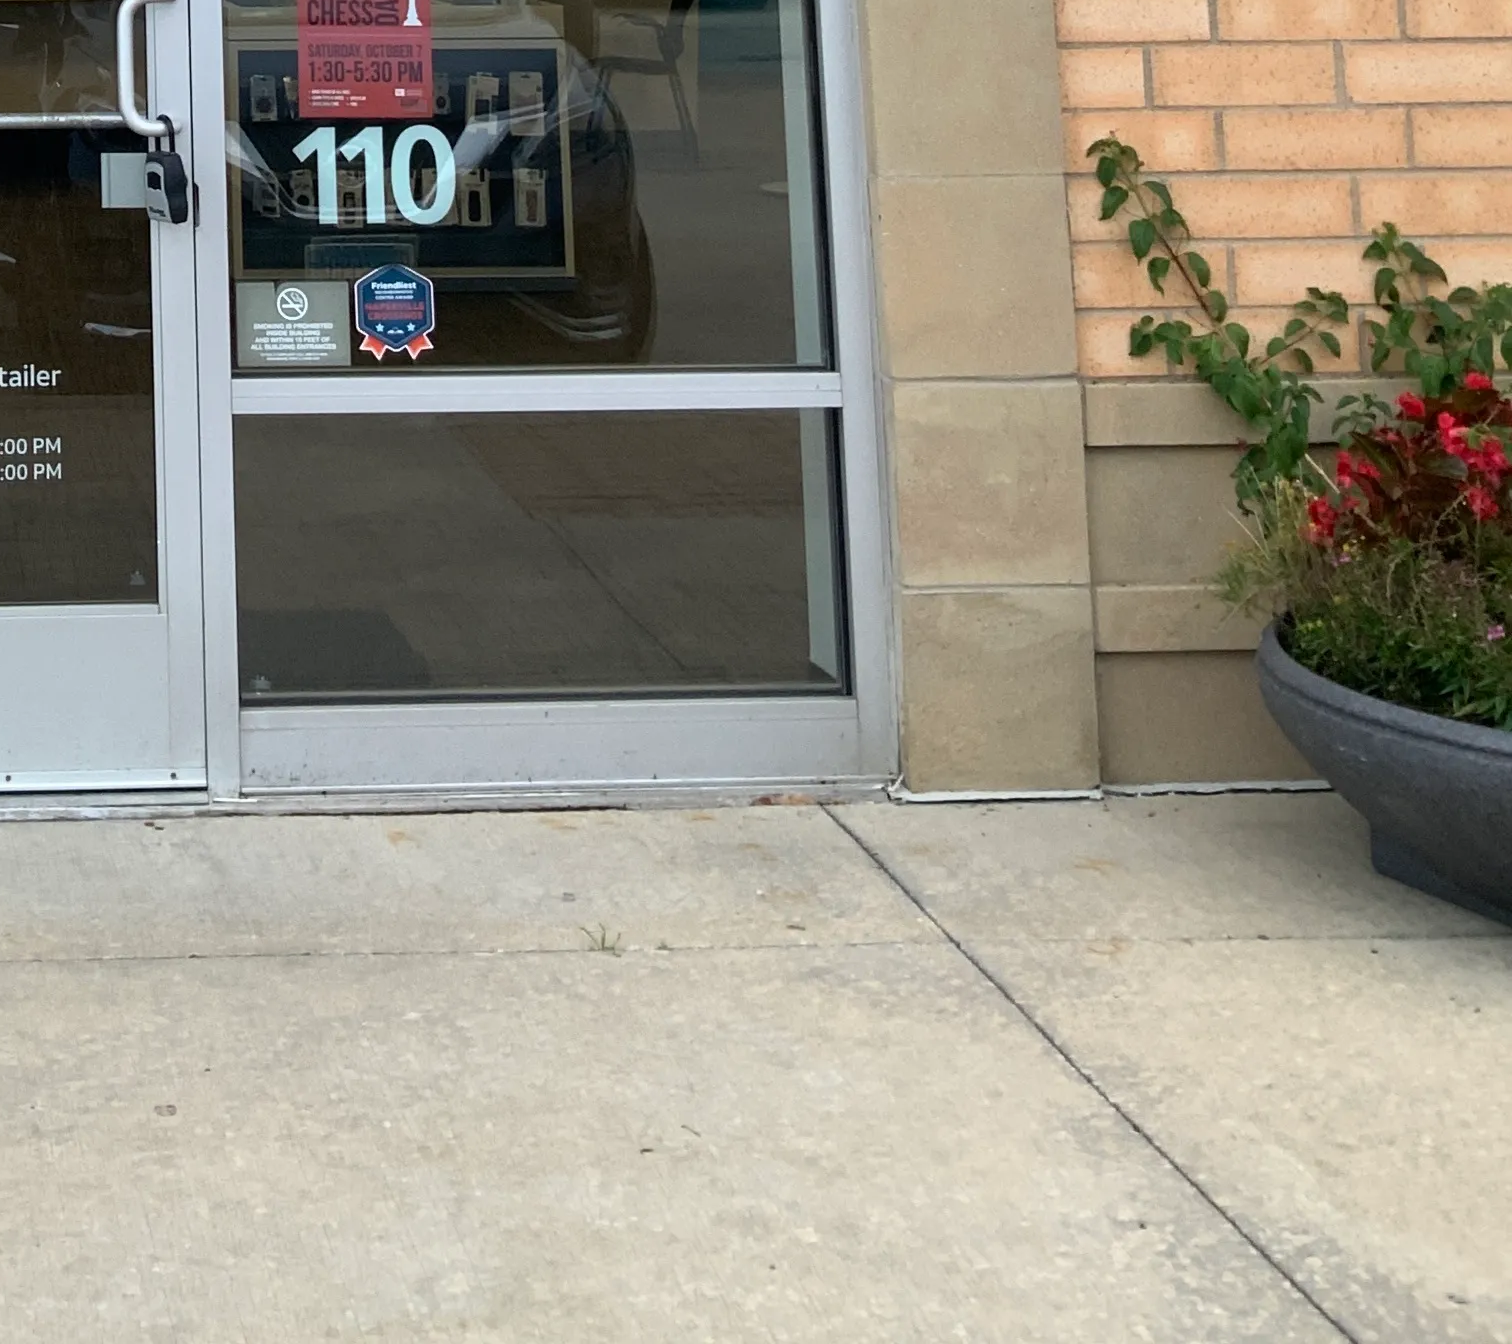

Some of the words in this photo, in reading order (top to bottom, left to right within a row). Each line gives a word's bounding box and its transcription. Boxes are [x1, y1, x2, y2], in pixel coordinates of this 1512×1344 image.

[307, 0, 374, 26] CHESS
[308, 43, 363, 59] SATURDAY,
[365, 44, 413, 58] OCTOBER
[415, 44, 422, 58] 7
[308, 61, 392, 83] 1:30-5:30
[397, 61, 423, 83] PM
[292, 125, 456, 226] 110
[371, 281, 417, 290] Friendliest
[33, 437, 61, 455] PM
[33, 463, 62, 480] PM
